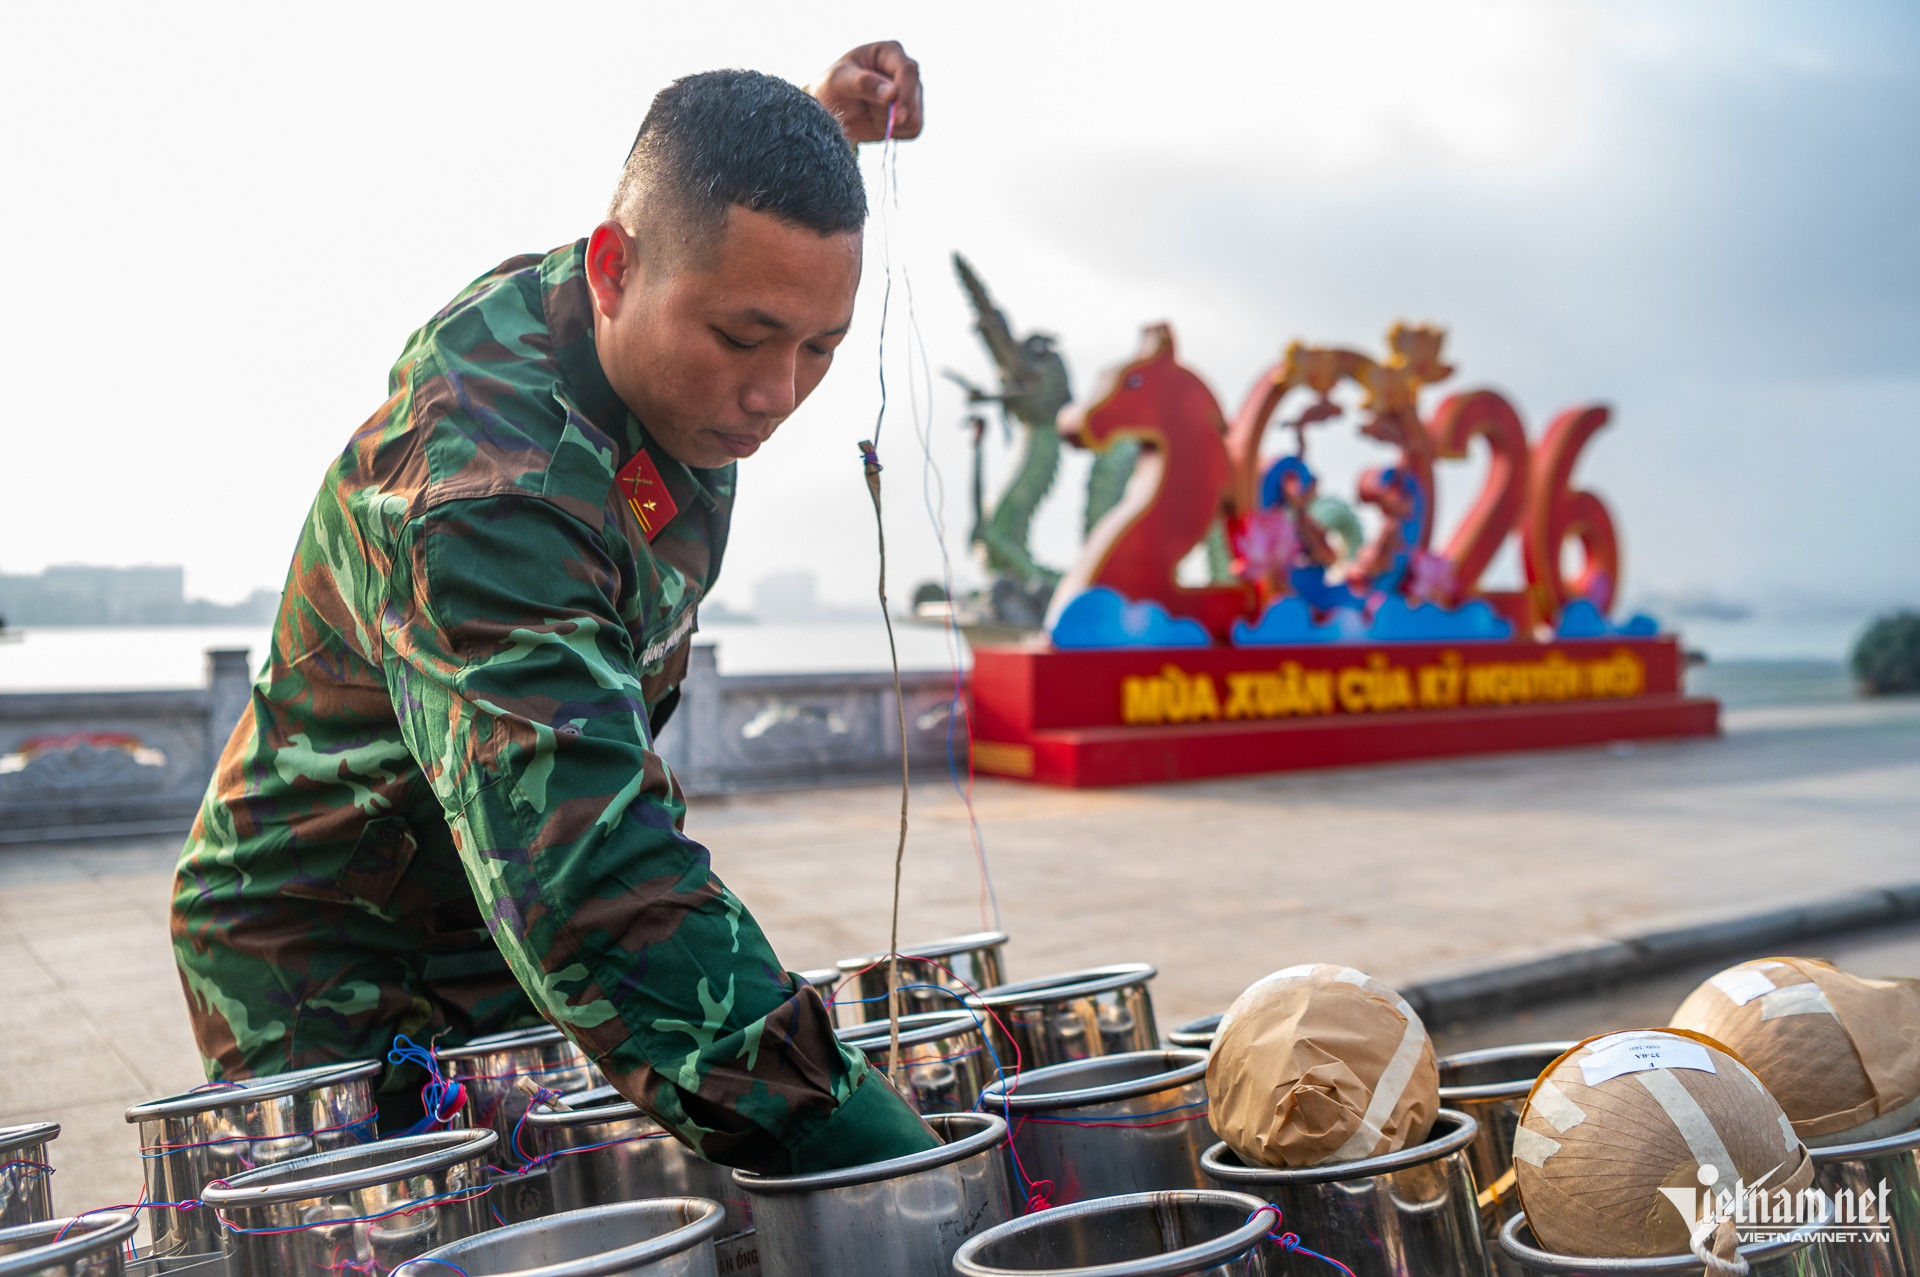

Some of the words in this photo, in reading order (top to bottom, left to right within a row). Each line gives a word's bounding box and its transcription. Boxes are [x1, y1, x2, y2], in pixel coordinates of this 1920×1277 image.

[1052, 322, 1622, 642] 2026
[1121, 662, 1219, 726] MÙA
[1225, 659, 1335, 721] XUÂN
[1336, 652, 1410, 713] CỦA
[736, 1247, 759, 1270] ỐNG
